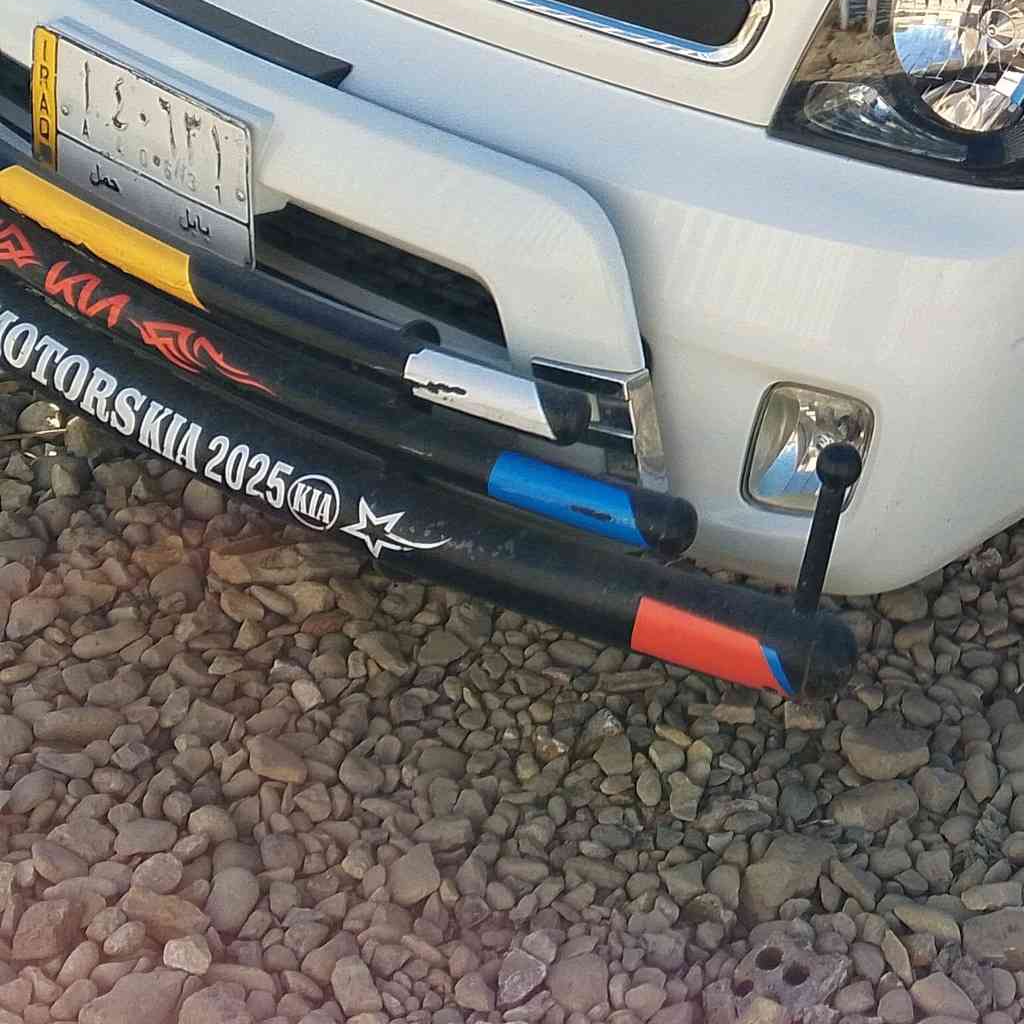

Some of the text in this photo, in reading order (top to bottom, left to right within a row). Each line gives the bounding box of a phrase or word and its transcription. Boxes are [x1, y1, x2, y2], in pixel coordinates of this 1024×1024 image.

[39, 38, 51, 143] IRAQ
[204, 435, 295, 509] 2025
[292, 482, 333, 524] KIA
